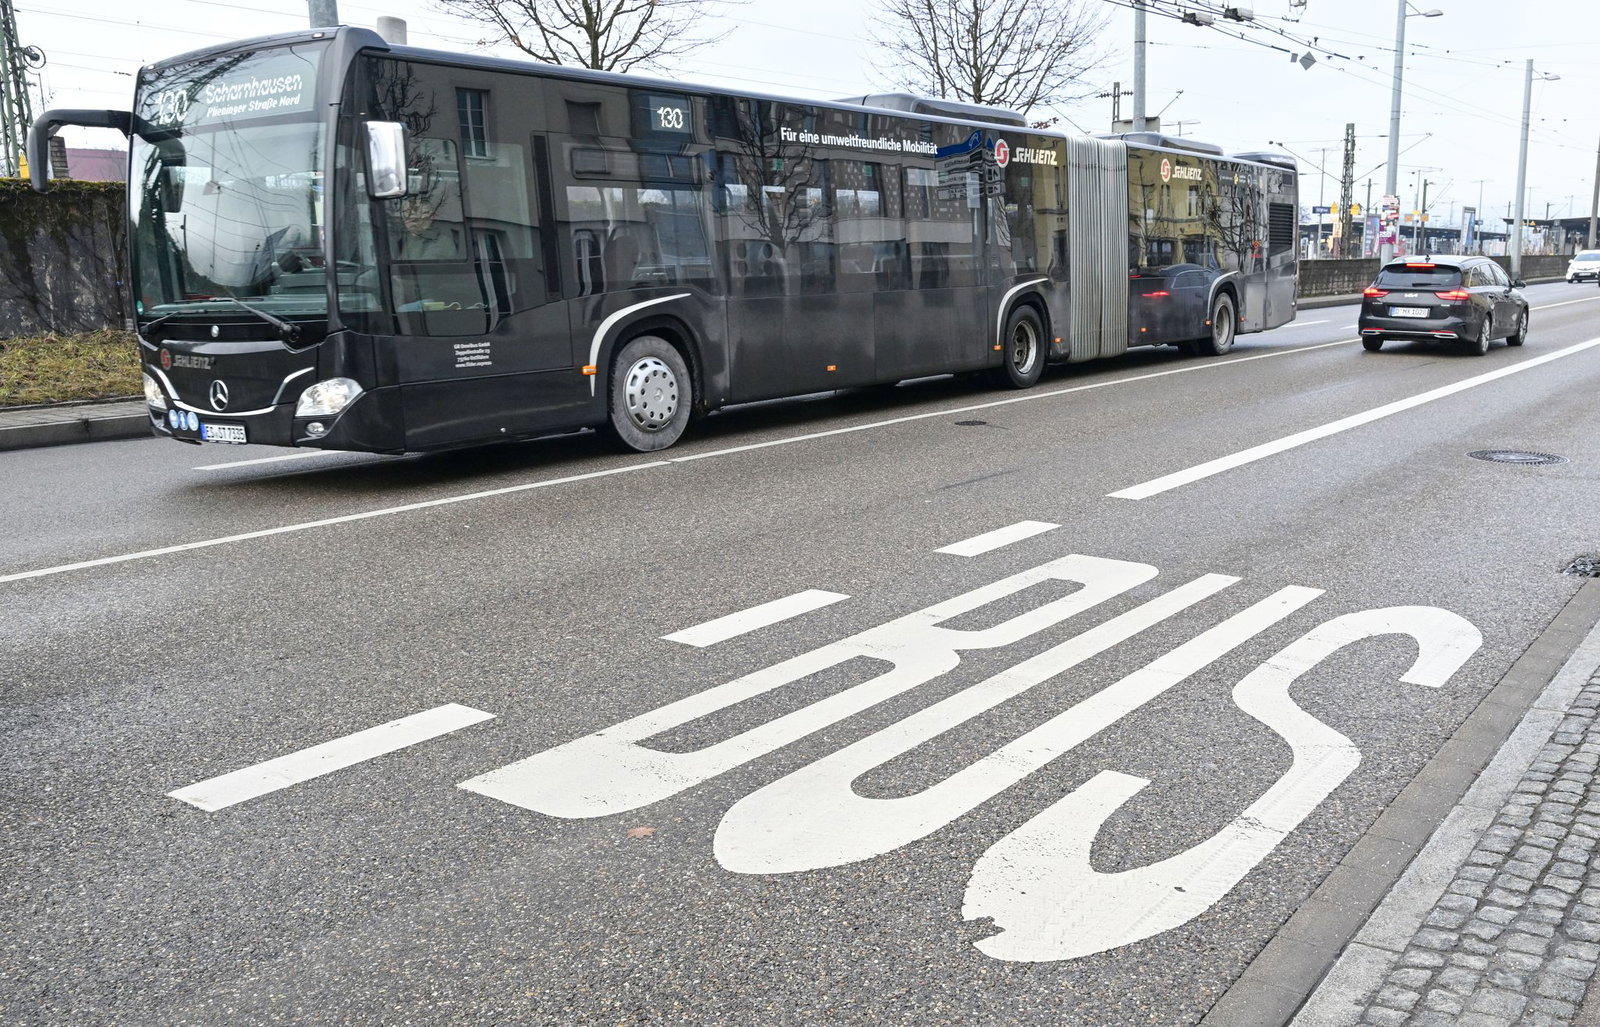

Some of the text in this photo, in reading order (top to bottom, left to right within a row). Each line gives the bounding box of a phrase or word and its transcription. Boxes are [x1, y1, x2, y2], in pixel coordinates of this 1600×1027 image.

[155, 74, 302, 125] 130 Scharnhausen
[206, 94, 300, 118] Plieninger Straße Nord
[656, 106, 684, 129] 130
[780, 126, 939, 155] Für eine umweltfreundliche Mobilität
[456, 553, 1482, 962] BUS
